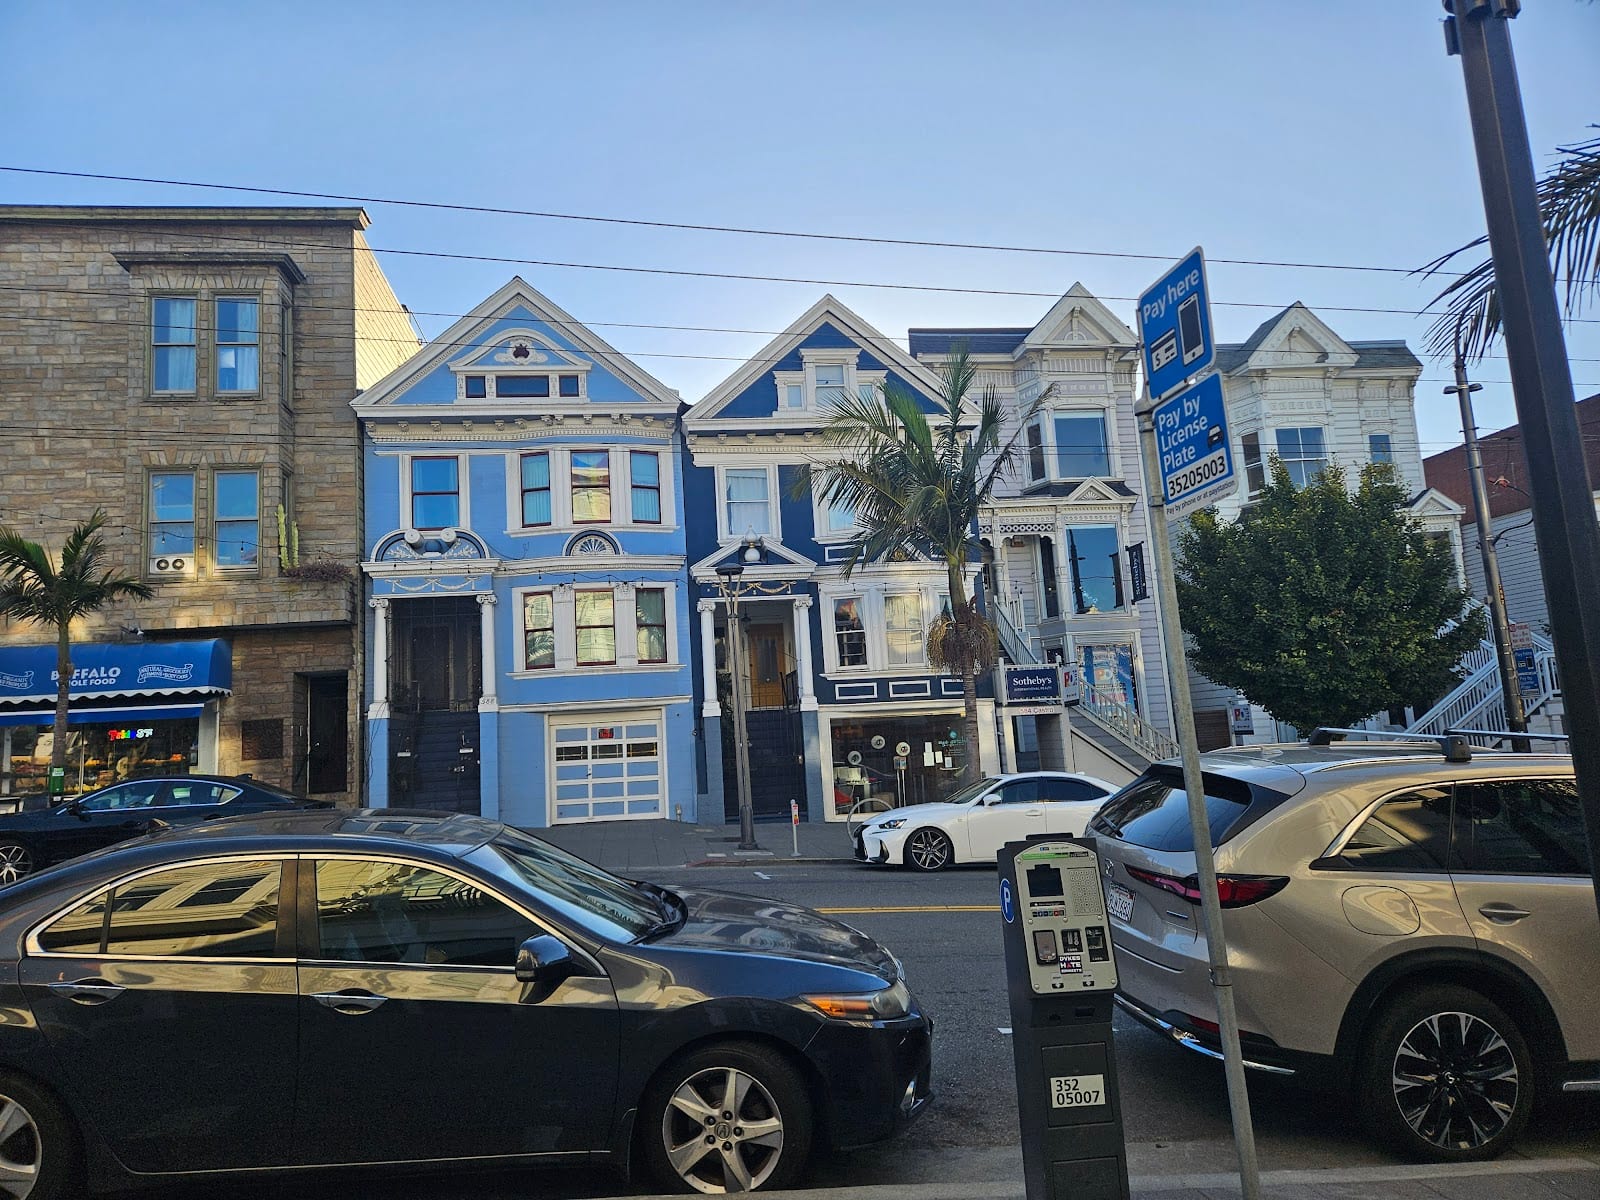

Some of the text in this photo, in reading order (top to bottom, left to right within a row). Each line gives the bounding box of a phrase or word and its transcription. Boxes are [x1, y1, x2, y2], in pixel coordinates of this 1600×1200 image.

[1143, 268, 1200, 325] Pay here
[1158, 395, 1201, 432] Pay by
[1161, 415, 1208, 452] License
[1163, 445, 1196, 473] Plate
[1168, 456, 1226, 497] 35205003
[1166, 507, 1175, 515] Pay
[1175, 504, 1181, 512] by
[1181, 498, 1197, 509] phone
[1196, 494, 1203, 502] or
[1202, 491, 1209, 499] at
[51, 667, 121, 681] BFFALO
[89, 678, 116, 686] FOOD
[1012, 675, 1053, 686] Sotheby's
[1056, 1079, 1079, 1092] 352
[1056, 1090, 1100, 1106] 05007
